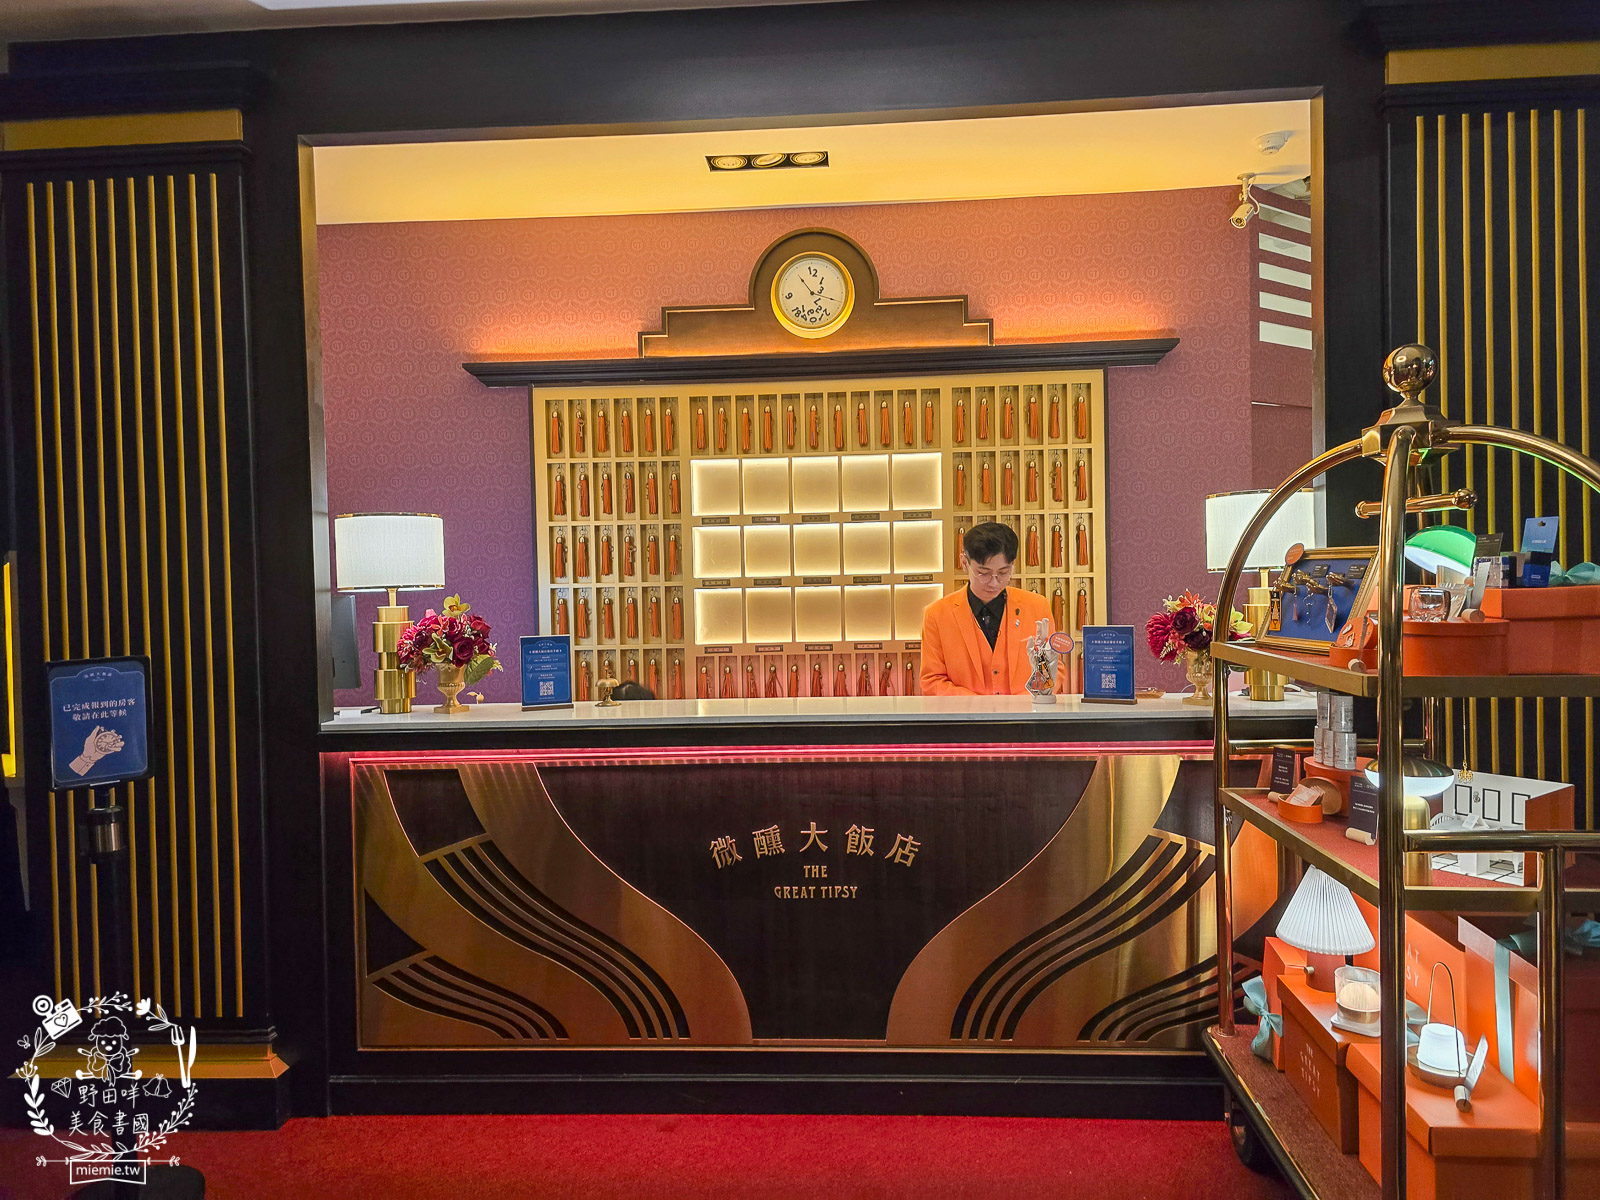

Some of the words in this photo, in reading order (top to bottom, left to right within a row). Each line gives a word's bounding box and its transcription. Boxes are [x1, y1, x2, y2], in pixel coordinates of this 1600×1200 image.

[808, 266, 818, 277] 12
[63, 698, 136, 712] 已完成報到的房客
[72, 709, 127, 722] 敬請在此等候
[709, 821, 922, 869] 微醺大飯店
[804, 865, 828, 878] THE
[773, 886, 816, 899] GREAT
[820, 886, 858, 899] TIPSY
